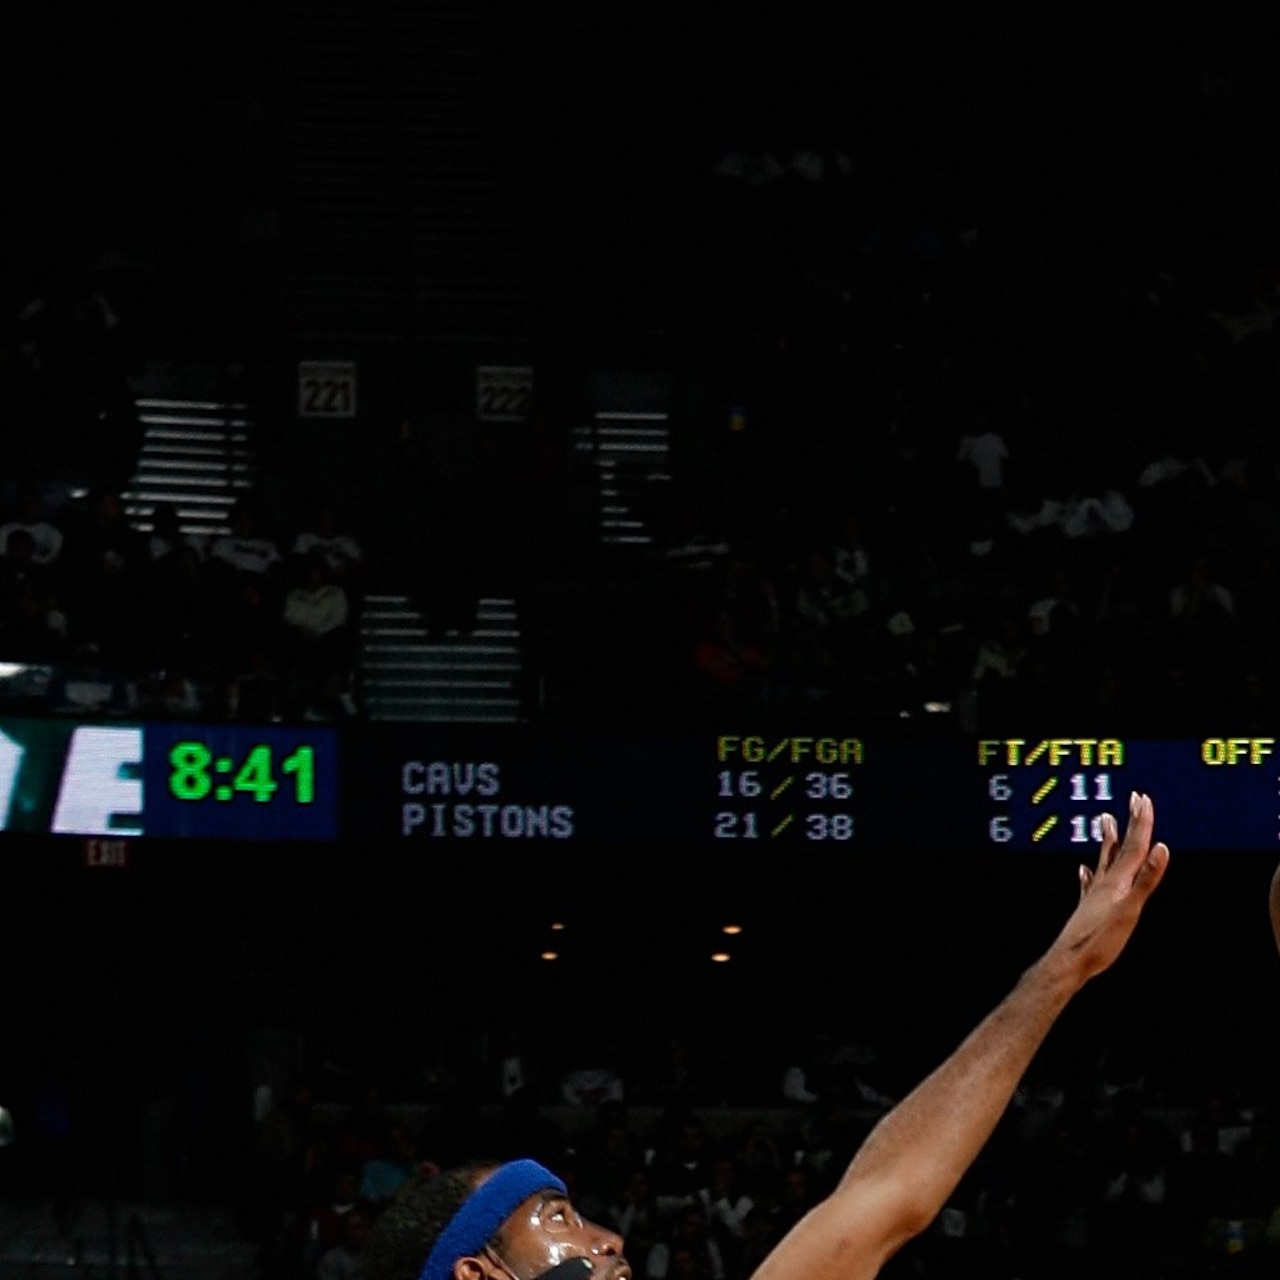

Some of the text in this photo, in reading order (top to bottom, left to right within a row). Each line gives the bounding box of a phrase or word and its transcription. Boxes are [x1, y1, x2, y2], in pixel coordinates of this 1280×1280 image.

[717, 736, 864, 764] FG/FGA
[978, 739, 1124, 765] FT/FTA
[1202, 738, 1274, 764] OFF
[169, 742, 316, 802] 8:41
[402, 761, 499, 796] CAVS
[717, 771, 762, 797] 16
[805, 772, 853, 799] 36
[988, 774, 1012, 801] 6
[1070, 774, 1112, 800] 11
[402, 803, 574, 838] PISTONS
[714, 814, 759, 839] 21
[805, 814, 854, 841] 38
[988, 815, 1012, 842] 6
